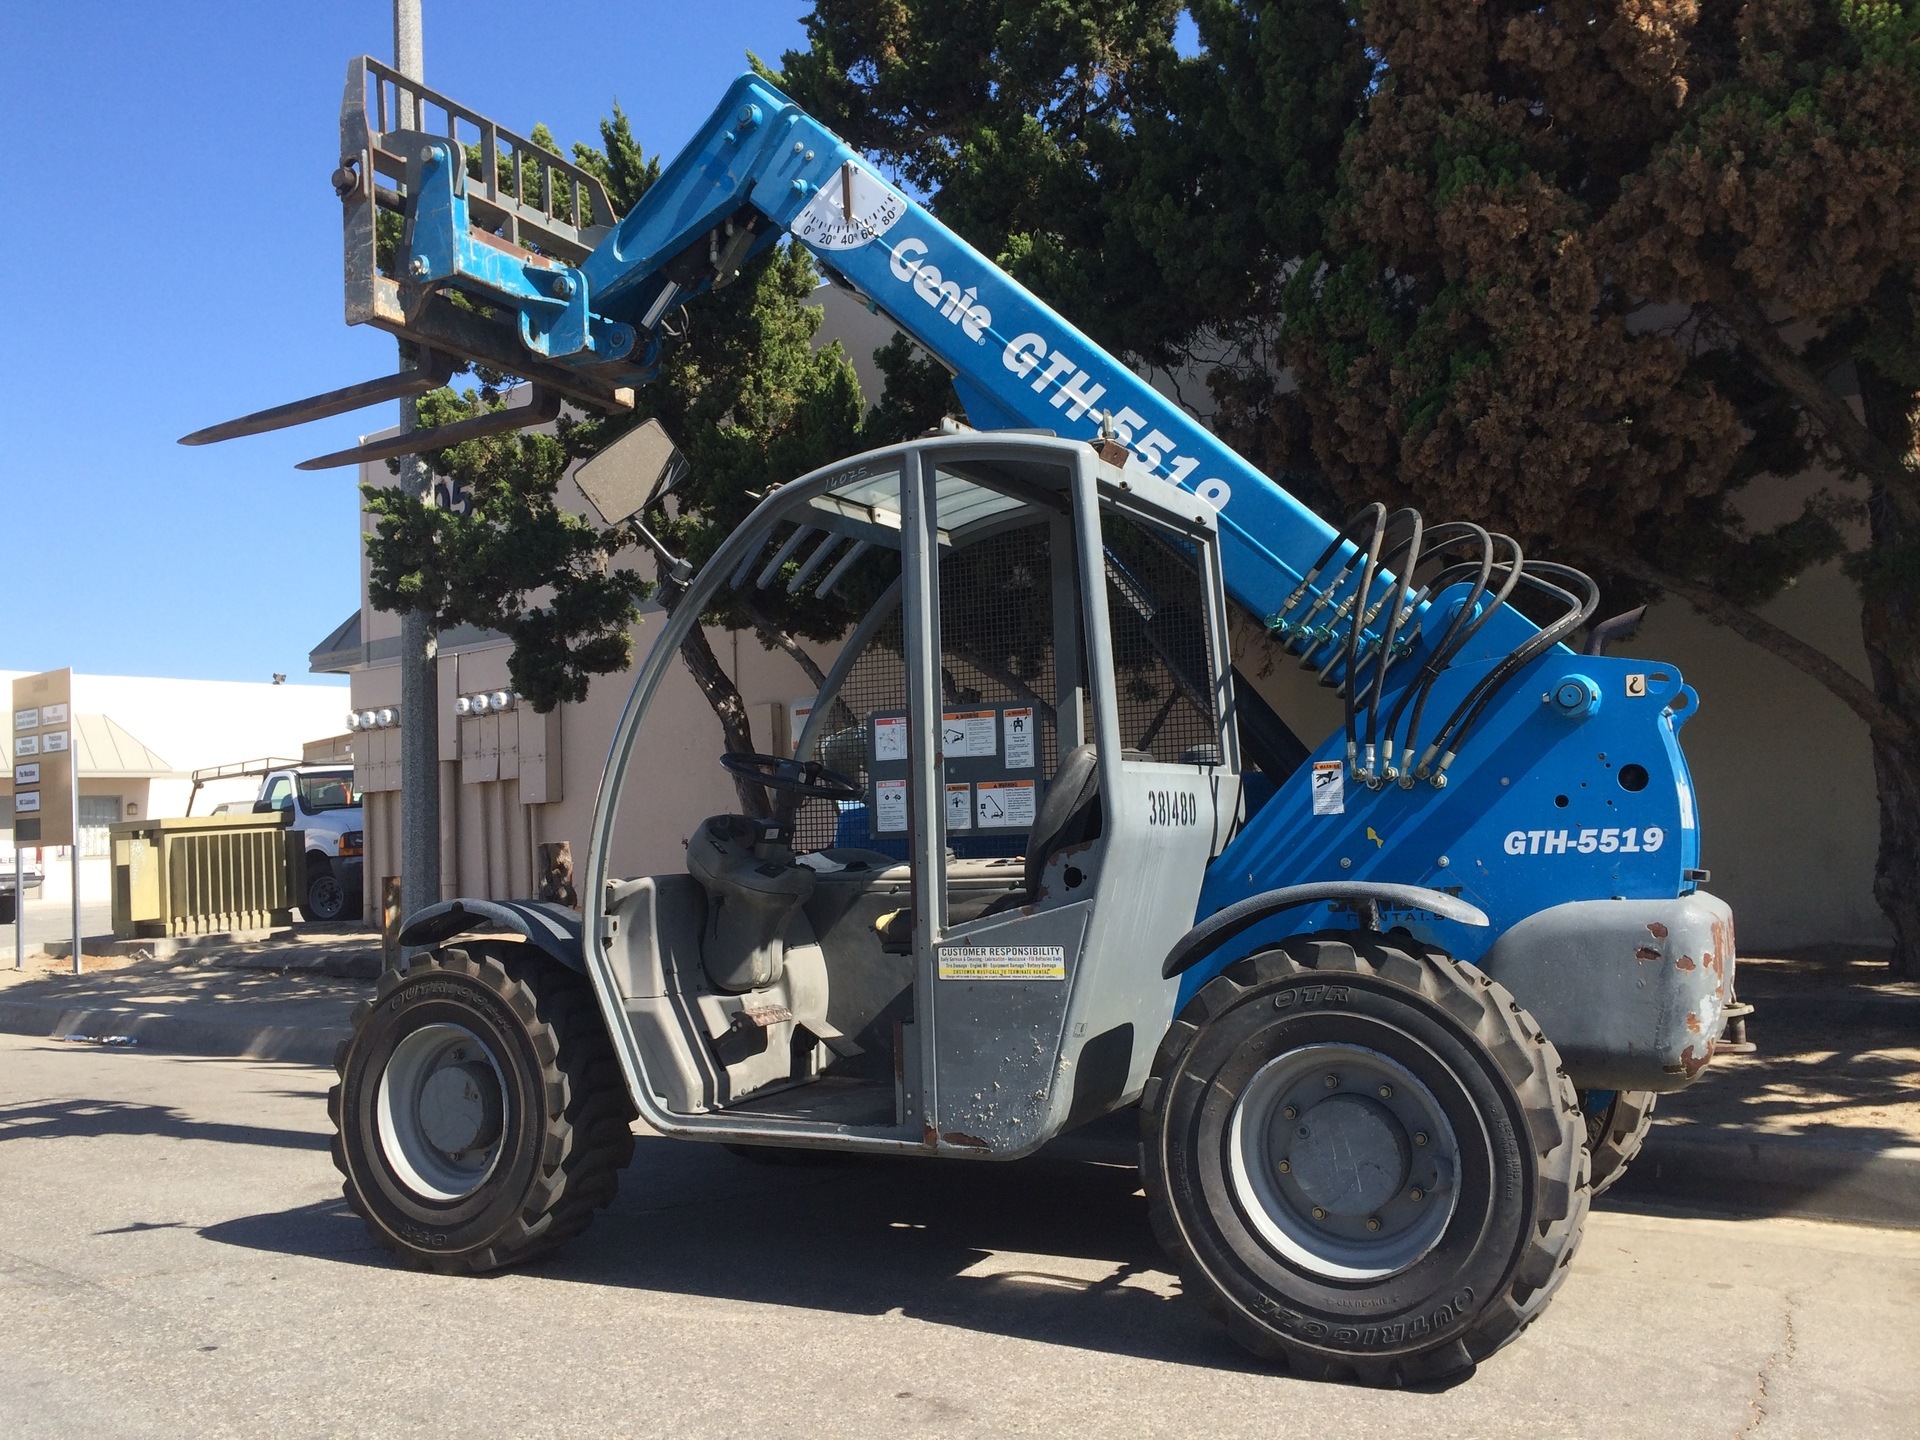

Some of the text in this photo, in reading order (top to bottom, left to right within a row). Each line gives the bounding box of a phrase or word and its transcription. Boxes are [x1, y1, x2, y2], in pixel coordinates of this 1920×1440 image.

[819, 232, 837, 245] 20°
[841, 233, 858, 245] 40°
[881, 206, 896, 226] 80°
[889, 237, 992, 344] Genie
[1148, 790, 1197, 827] 381480
[1503, 827, 1665, 856] GTH-5519
[941, 947, 1060, 957] CUSTOMER RESPONSIBILITY
[1274, 984, 1351, 1008] OTR
[1252, 1286, 1475, 1345] OUTRIGGER
